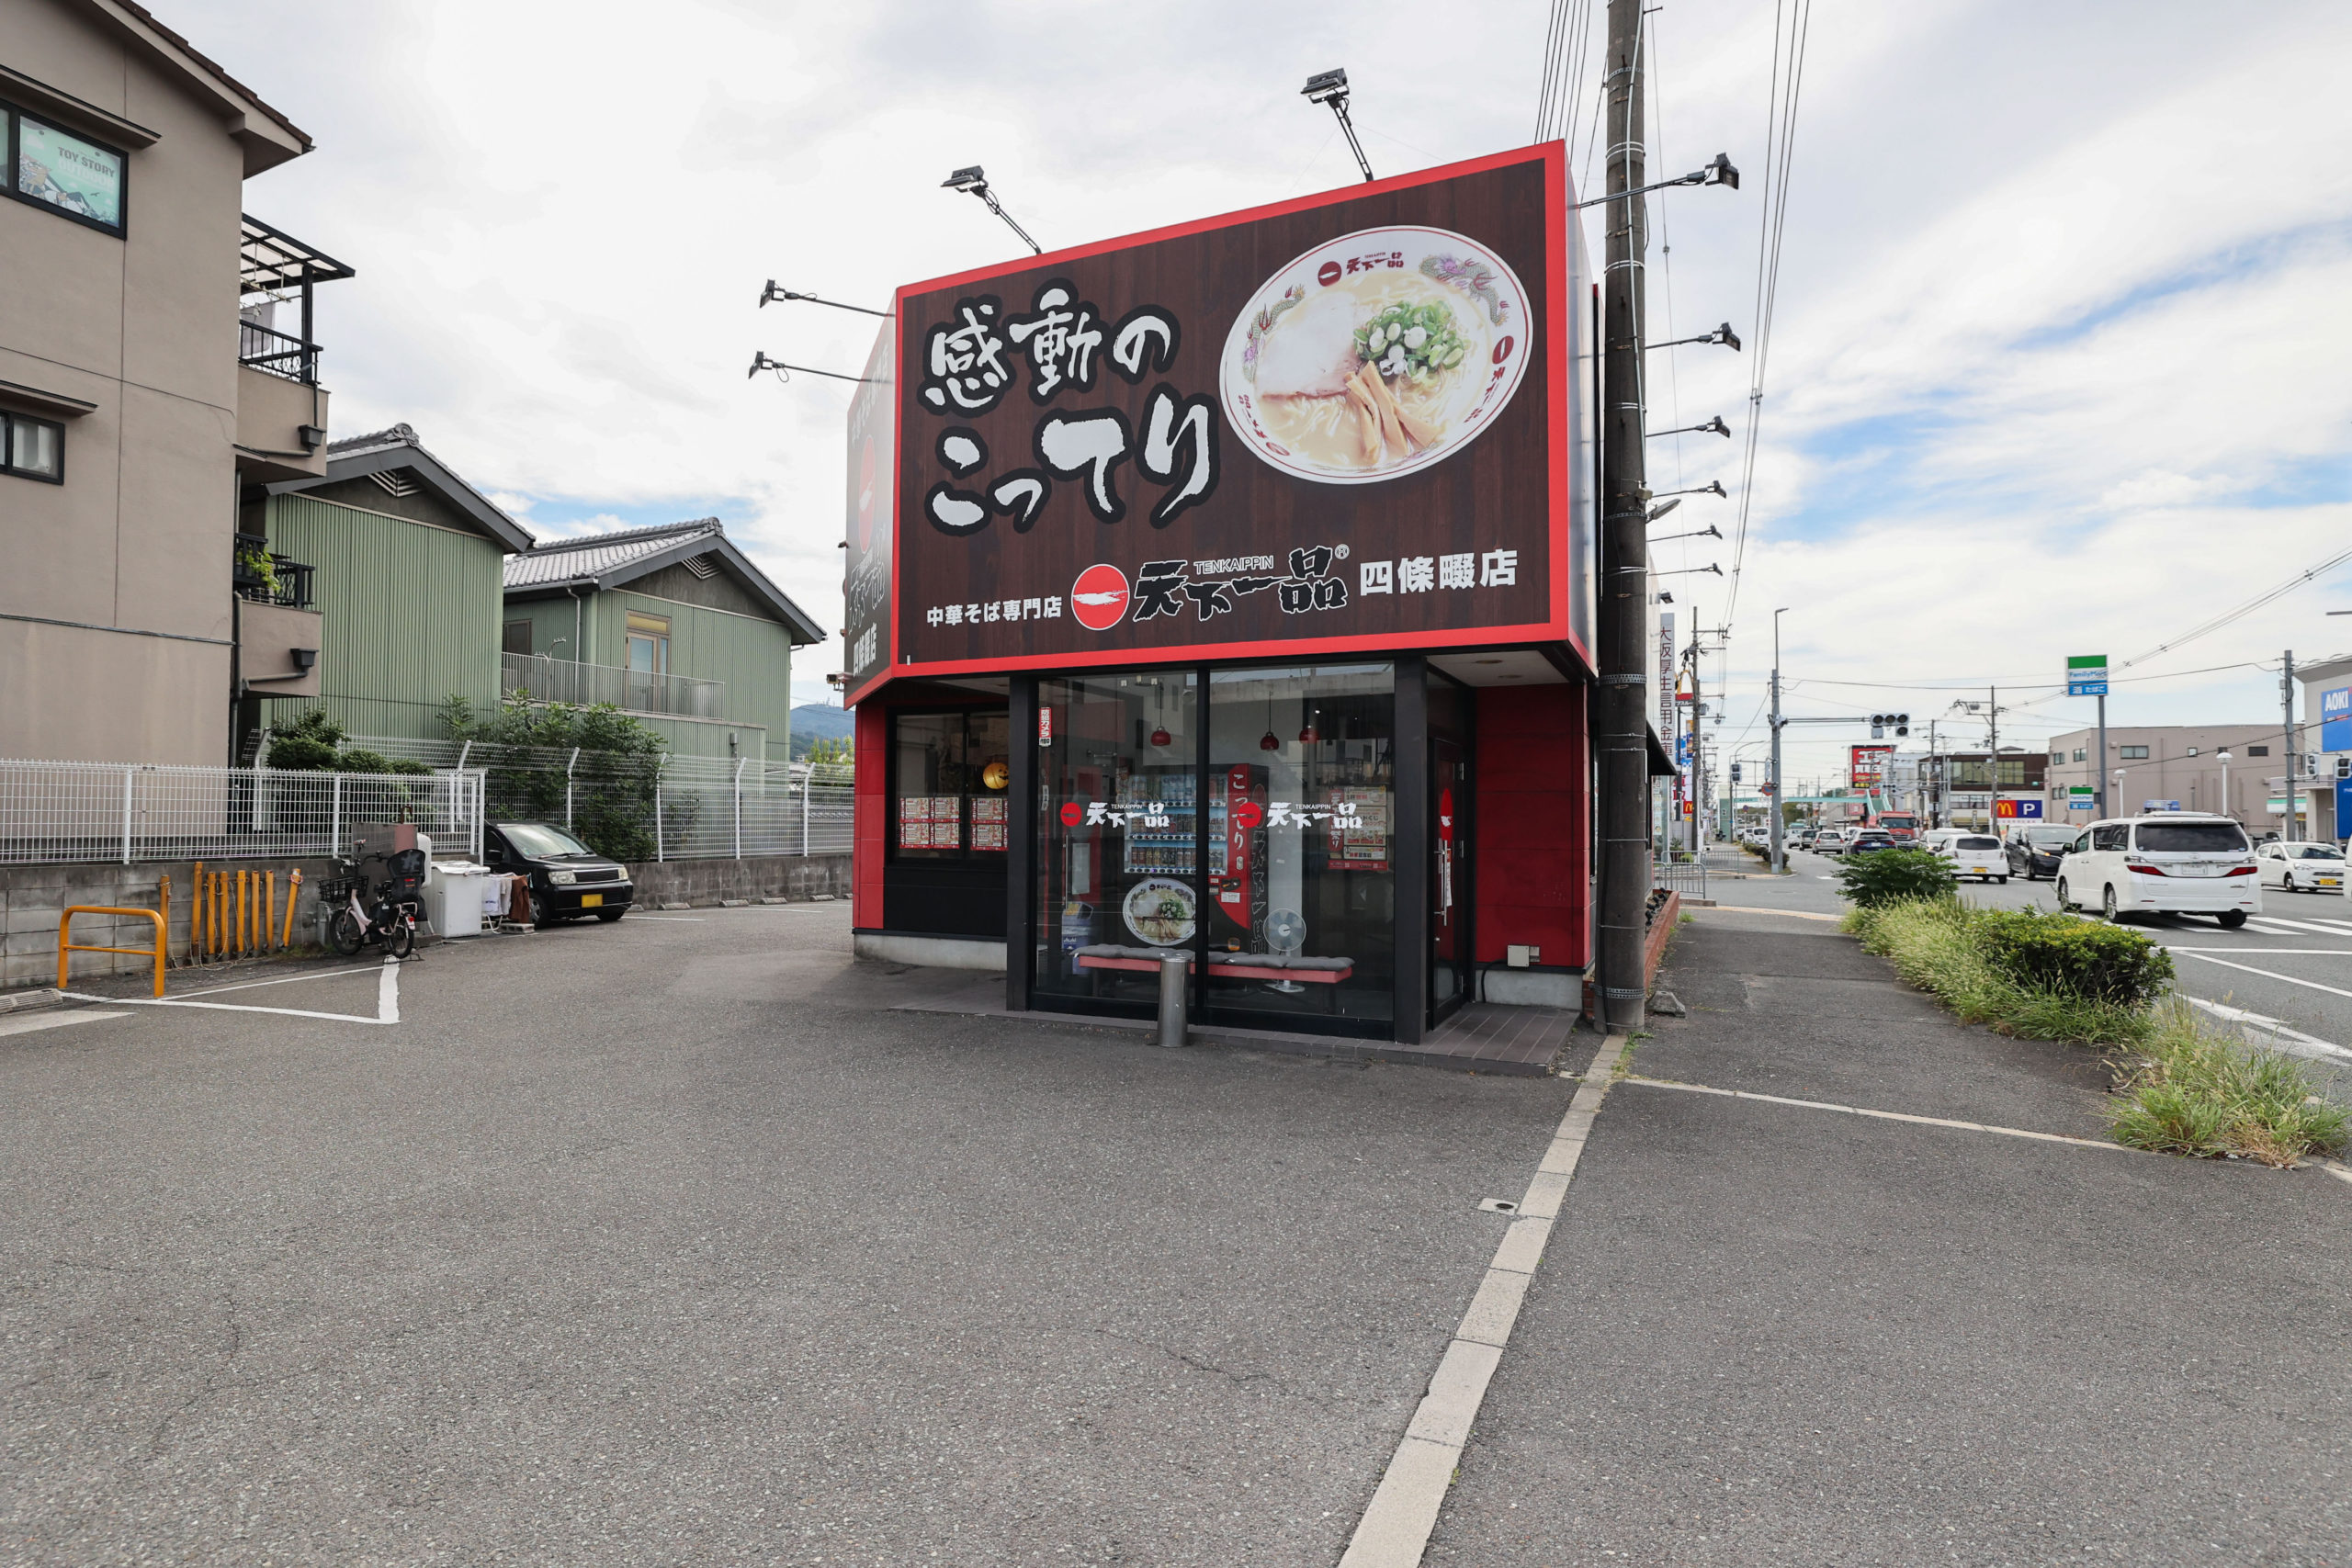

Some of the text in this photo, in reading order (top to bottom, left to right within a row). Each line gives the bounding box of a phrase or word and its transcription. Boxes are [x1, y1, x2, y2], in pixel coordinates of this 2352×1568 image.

[58, 146, 115, 178] TOY STORY
[1346, 251, 1404, 275] 天下一品
[924, 287, 1172, 410] 感動の
[932, 392, 1211, 528] こってり
[1193, 555, 1274, 575] TENKAIPPIN
[926, 545, 1518, 628] 中華そば専門店 天下一品 四條畷店
[2324, 691, 2349, 712] AOKI
[1086, 802, 1170, 829] 天下一品
[1267, 802, 1363, 829] 天下一品
[2023, 803, 2035, 815] P
